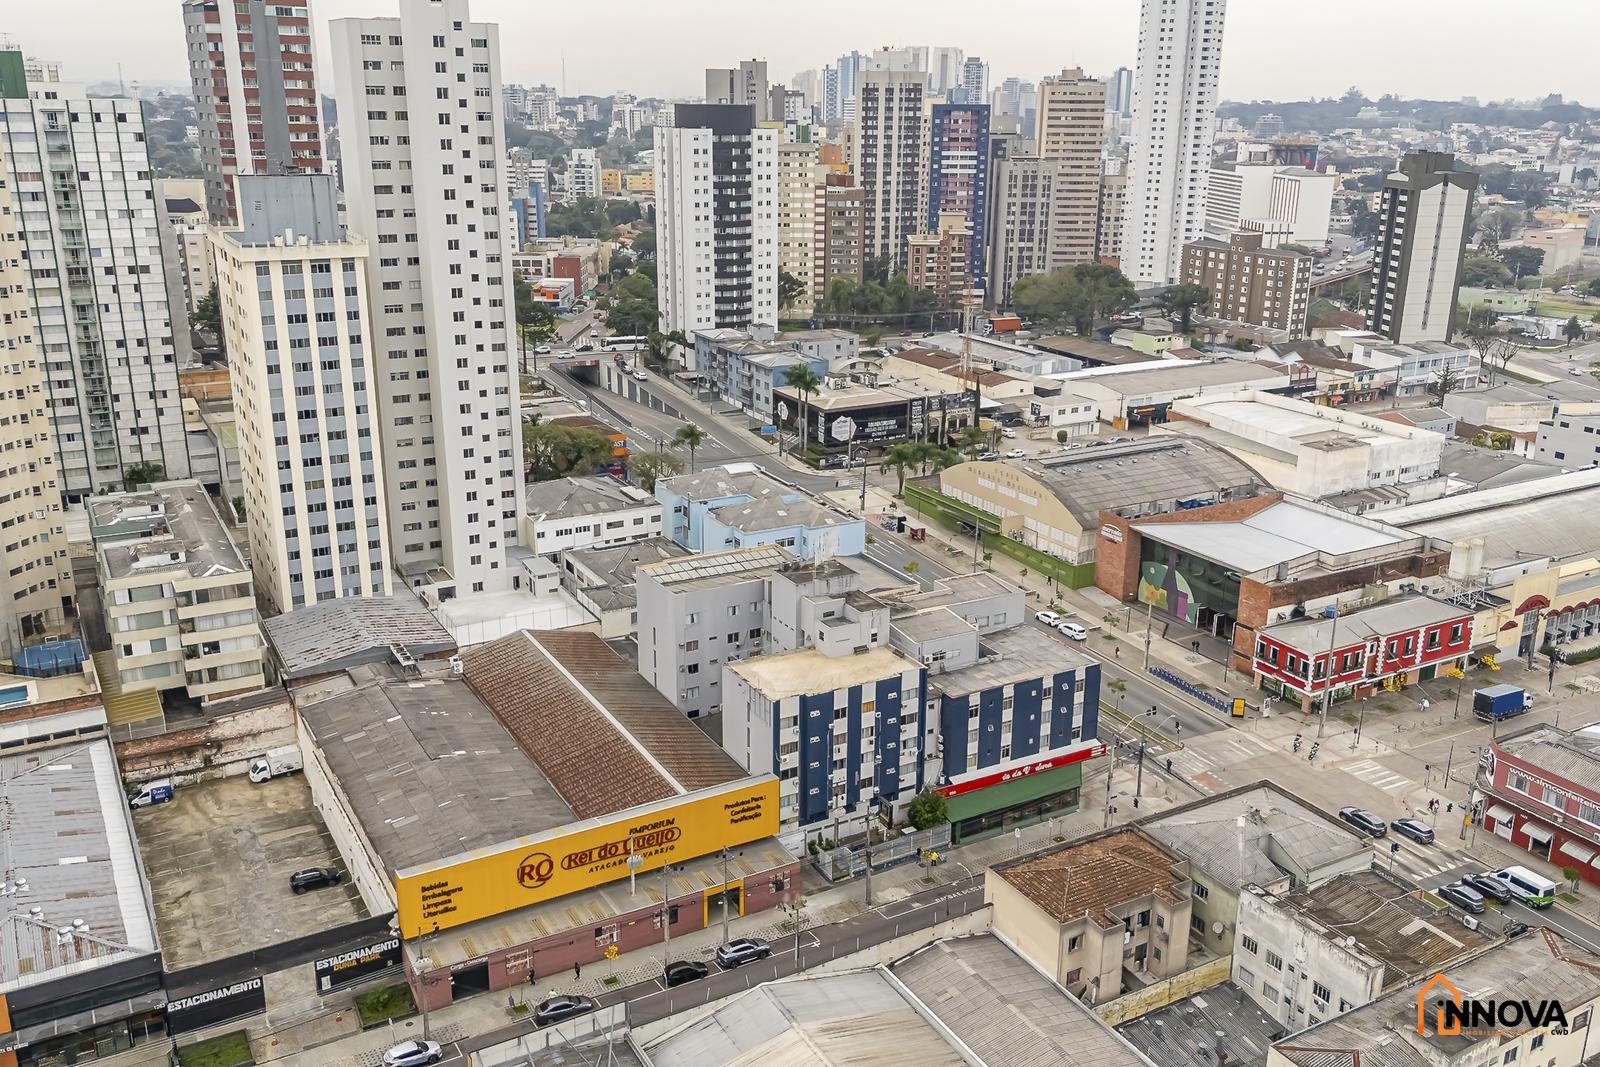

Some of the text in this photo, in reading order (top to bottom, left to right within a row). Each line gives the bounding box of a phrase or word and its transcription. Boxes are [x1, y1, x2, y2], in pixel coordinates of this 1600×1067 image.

[629, 818, 675, 835] EMPORIUM
[567, 851, 593, 869] Rei
[598, 842, 617, 858] do
[623, 828, 675, 852] Queijo
[643, 844, 675, 859] VAREJO
[518, 858, 554, 884] RQ
[421, 881, 448, 893] Bebidas
[422, 898, 452, 910] Limpeza
[316, 938, 399, 970] ESTACIONAMENTO
[167, 979, 261, 1012] ESTACIONAMENTO
